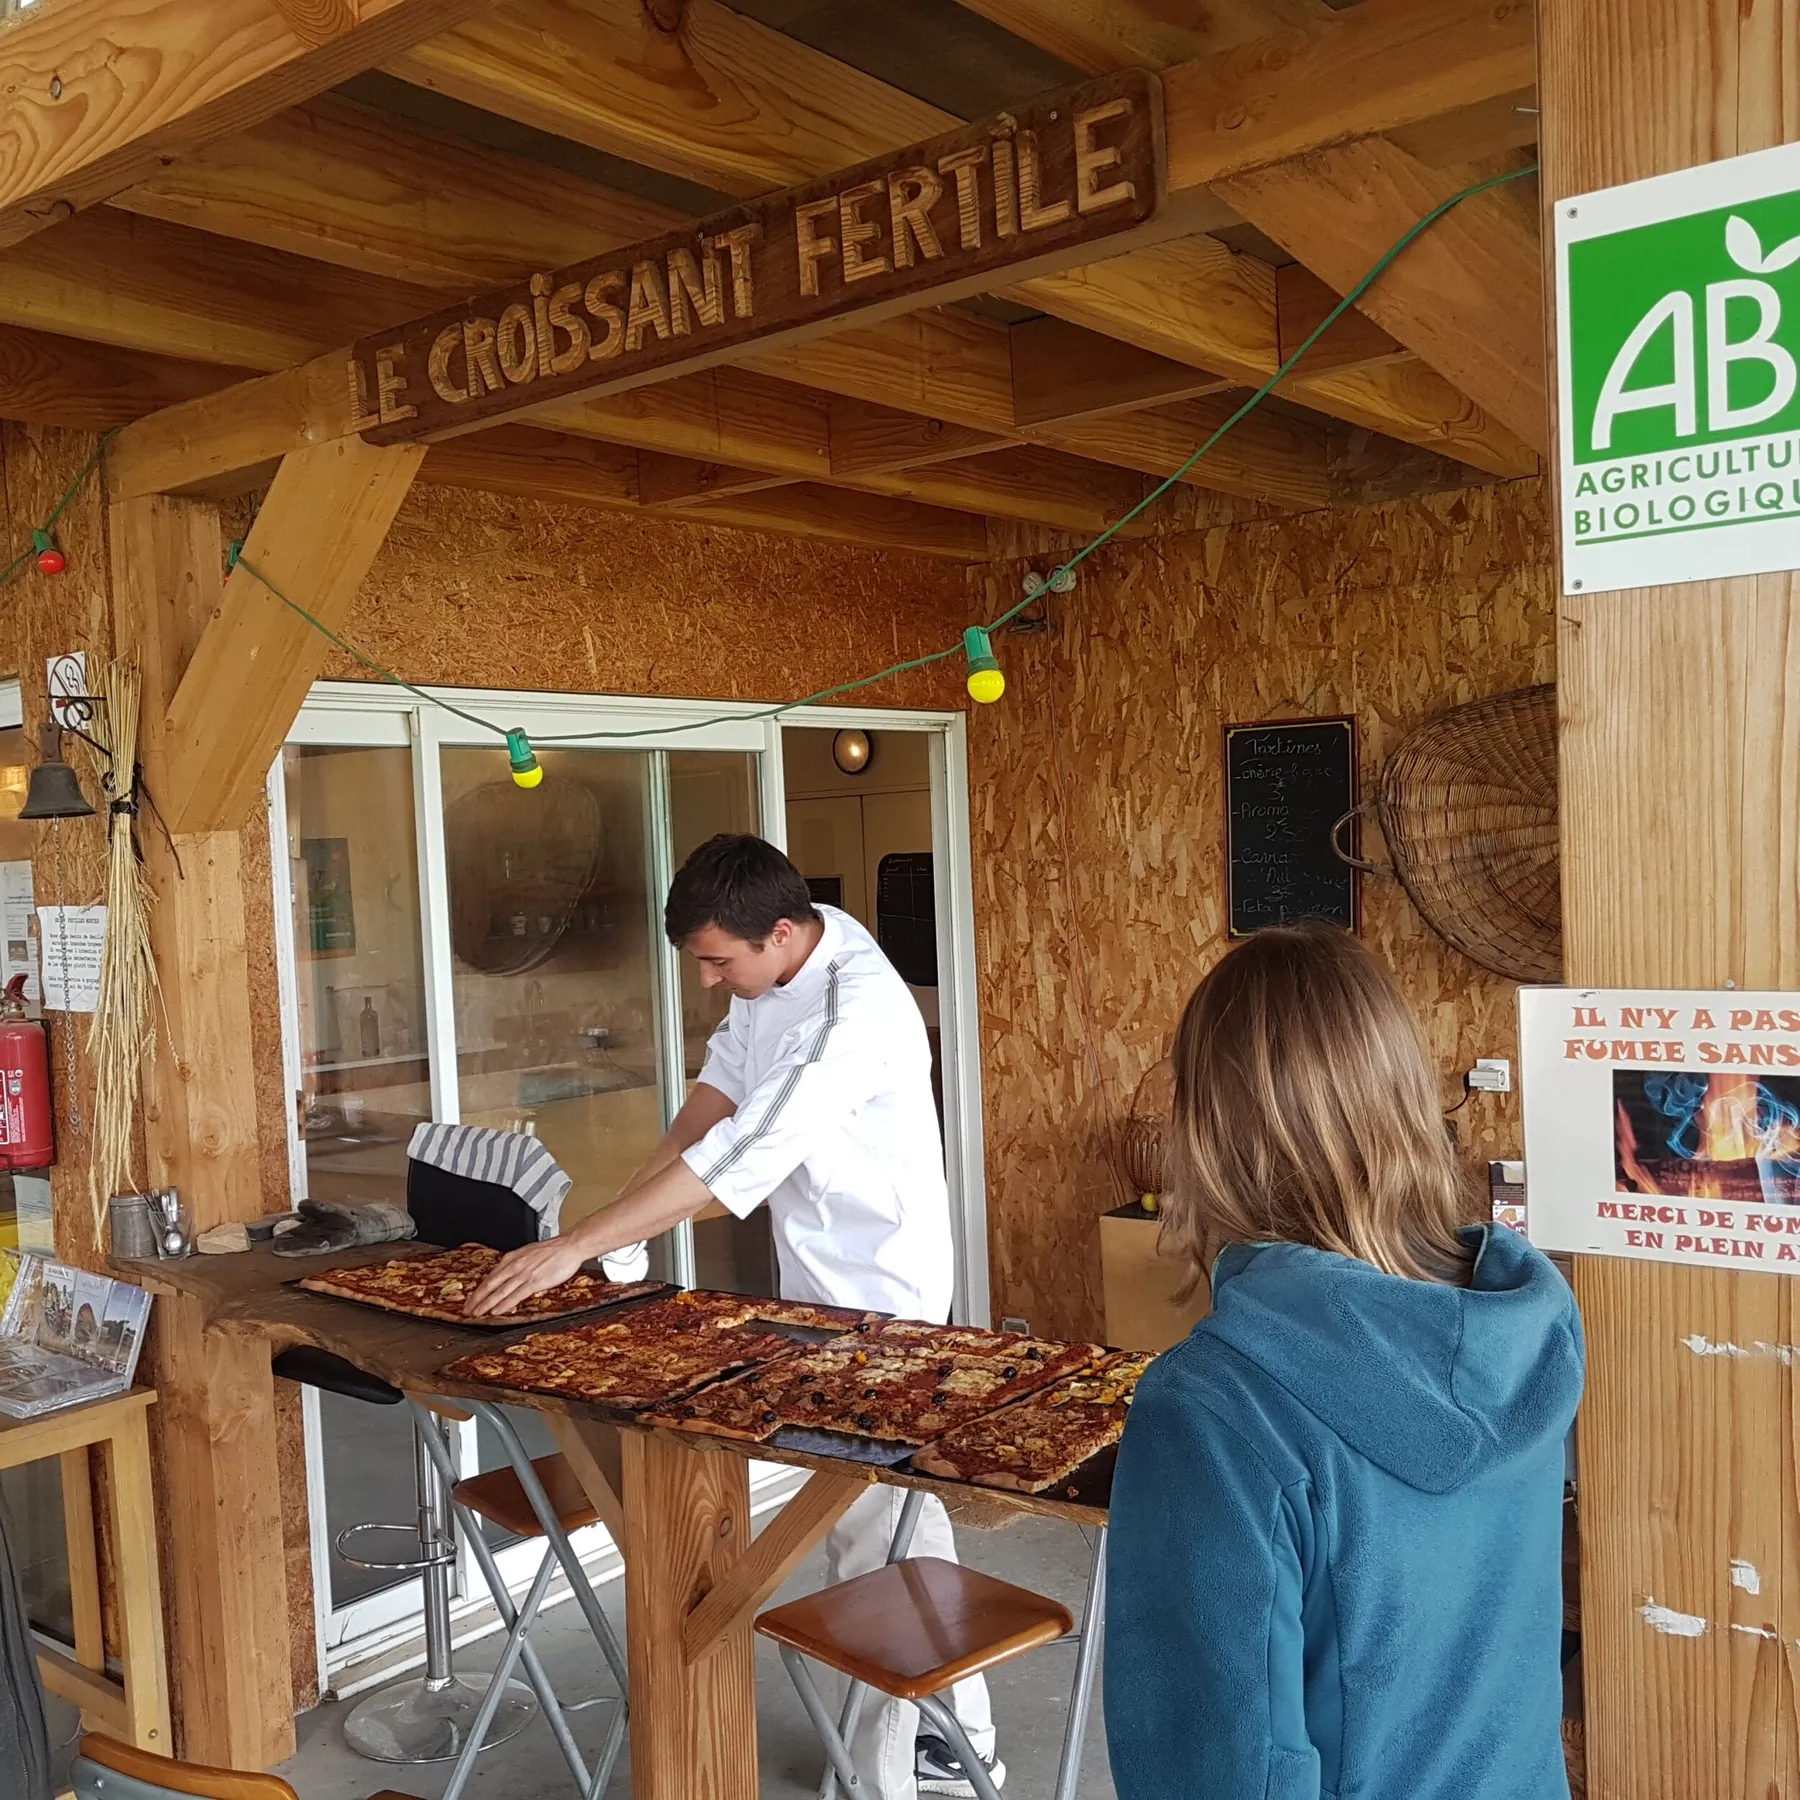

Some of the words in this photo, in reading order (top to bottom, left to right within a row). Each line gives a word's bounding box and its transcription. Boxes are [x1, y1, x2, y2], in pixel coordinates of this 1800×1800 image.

[347, 345, 418, 434] LE
[427, 224, 762, 402] CROISSANT
[796, 96, 1136, 297] FERTILE
[1591, 278, 1798, 450] AB
[1572, 1006, 1607, 1028] IL
[1619, 1007, 1680, 1030] N'Y
[1690, 1008, 1717, 1030] A
[1729, 1009, 1800, 1032] PAS
[1563, 1038, 1686, 1064] FUMEE
[1697, 1042, 1800, 1066] SANS
[1597, 1202, 1688, 1225] MERCI
[1696, 1209, 1736, 1229] DE
[1624, 1229, 1664, 1249] EN
[1675, 1234, 1765, 1259] PLEIN
[1775, 1242, 1800, 1262] A
